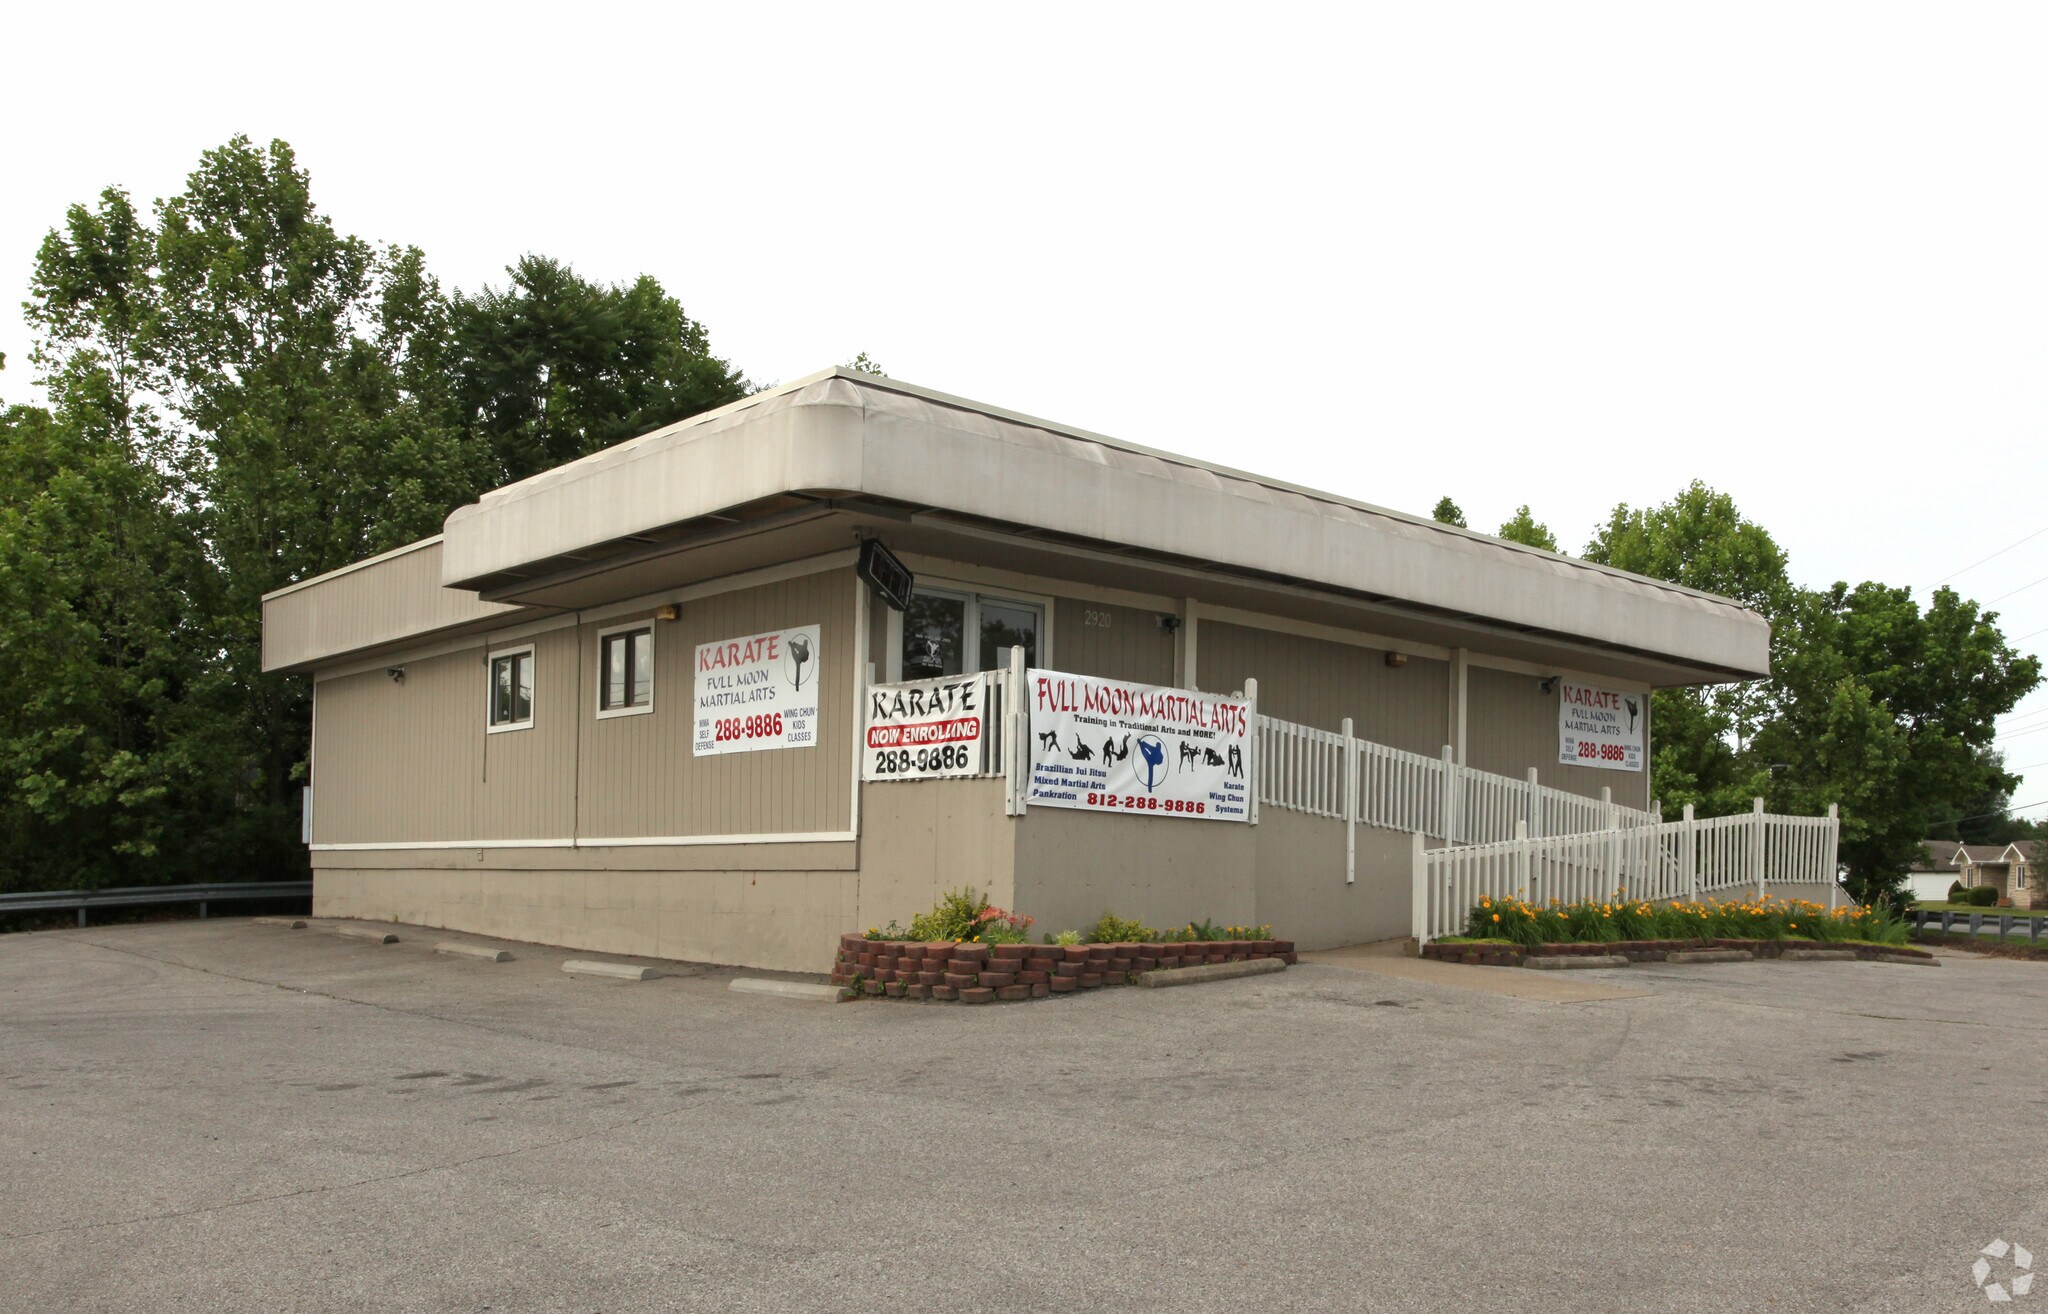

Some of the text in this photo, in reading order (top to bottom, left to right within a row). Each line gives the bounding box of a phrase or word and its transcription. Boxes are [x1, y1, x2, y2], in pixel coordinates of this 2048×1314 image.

[1085, 610, 1111, 628] 2920
[699, 635, 781, 672] KARATE
[707, 669, 769, 690] FULL MOON
[700, 686, 776, 709] MARTIAL ARTS
[872, 681, 976, 720] KARATE
[1563, 685, 1620, 710] KARATE
[784, 707, 815, 719] WING CHUN
[1037, 677, 1246, 737] FULL MOON MARTIAL ARTS
[1572, 708, 1616, 722] FULL MOON
[715, 712, 783, 741] 288-9886
[792, 720, 805, 730] KIDS
[871, 720, 977, 744] NOW ENROLLING
[1074, 714, 1216, 739] Training in Traditional Arts and MORE!
[1565, 720, 1620, 735] MARTIAL ARTS
[700, 730, 709, 739] SELF
[788, 732, 811, 742] CLASSES
[695, 740, 714, 751] DEFENSE
[1578, 741, 1624, 761] 288-9886
[875, 745, 968, 774] 288-9886
[1561, 753, 1577, 761] DEFENSE
[1035, 763, 1107, 777] Brazillian Jui Jitsu
[1034, 776, 1106, 790] Mixed Martial Arts
[1223, 781, 1244, 790] Karate
[1033, 788, 1077, 800] Pankration
[1209, 792, 1244, 802] Wing Chun
[1087, 792, 1206, 814] 812-288-9886
[1215, 804, 1244, 814] Systema
